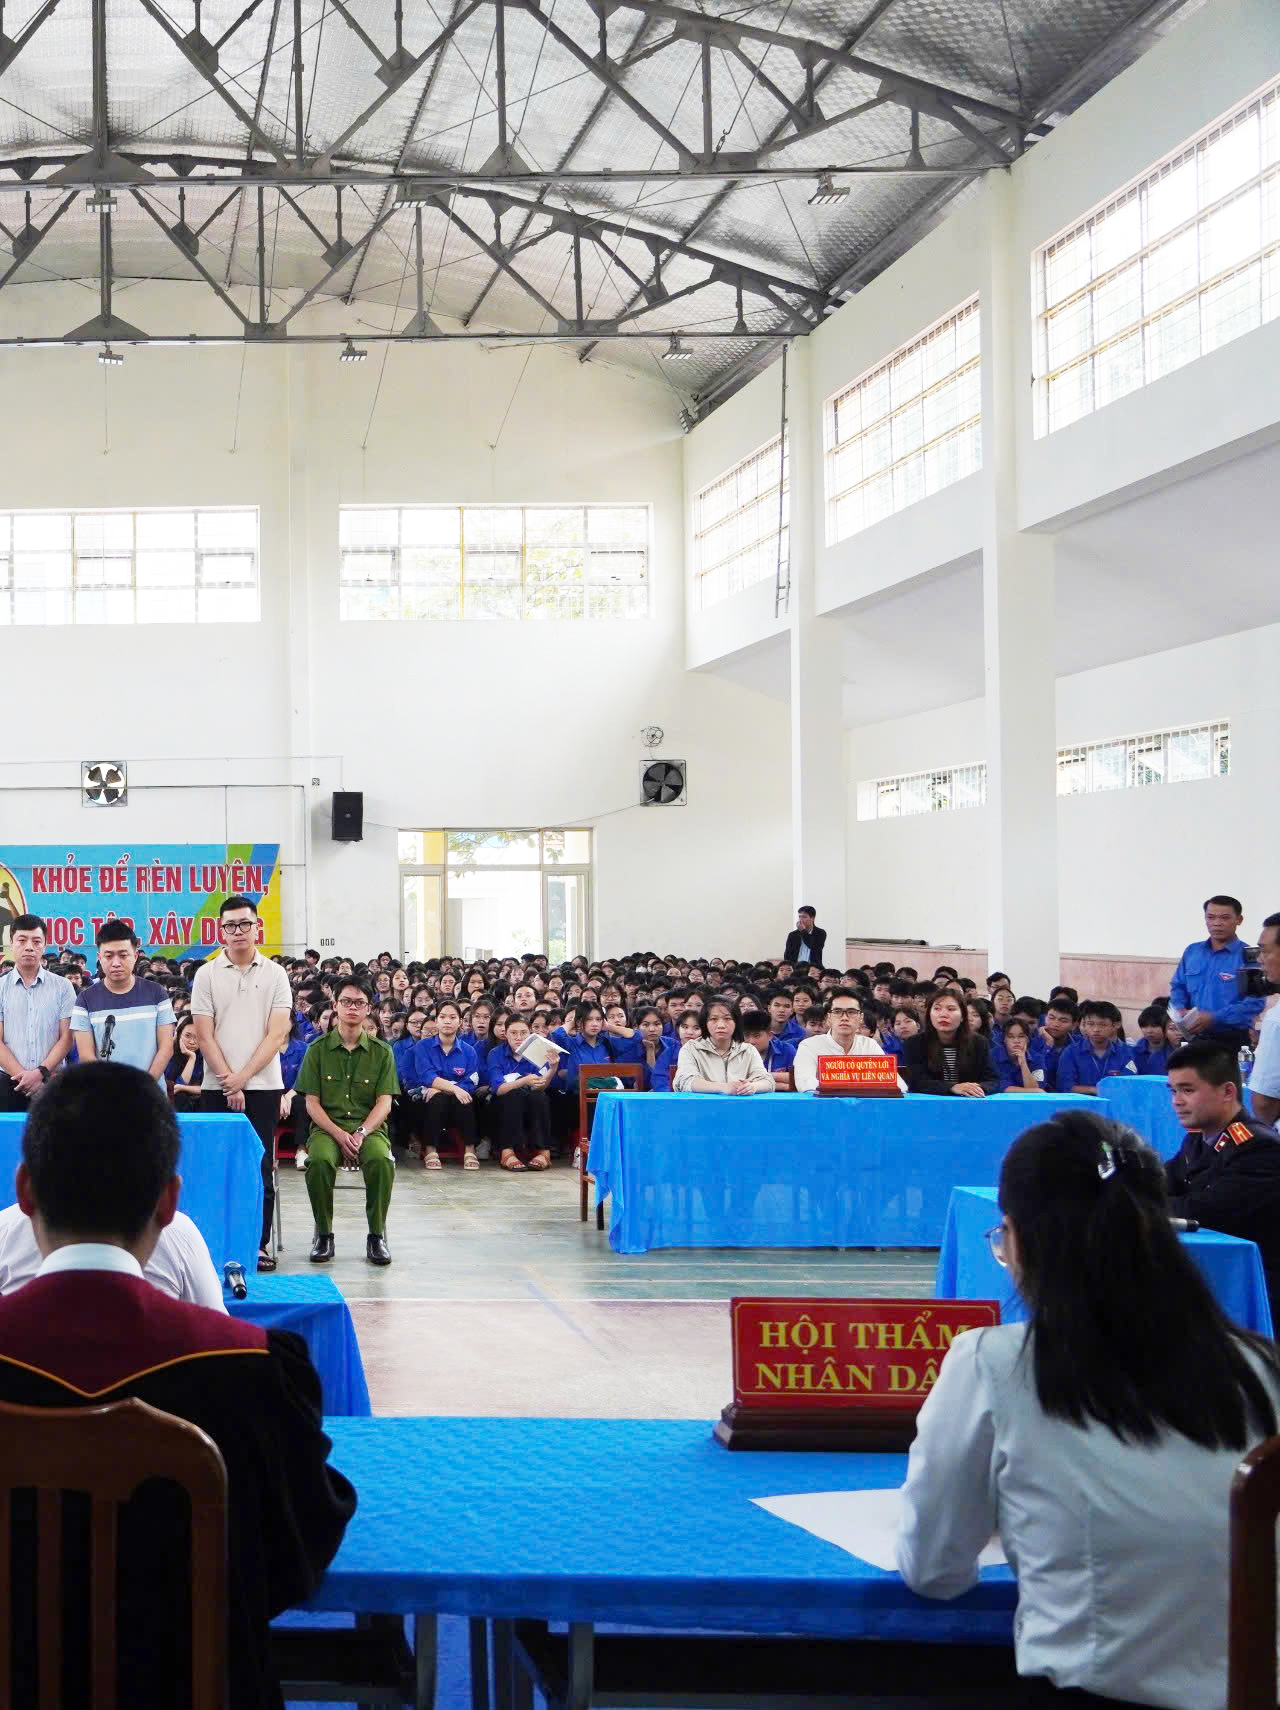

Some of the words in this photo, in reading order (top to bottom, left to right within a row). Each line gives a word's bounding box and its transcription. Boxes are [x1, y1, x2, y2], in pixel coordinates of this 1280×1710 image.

[32, 853, 91, 892] KHỎE
[99, 853, 130, 892] ĐỂ
[136, 859, 182, 892] RÈN
[149, 912, 194, 945] XÂY
[876, 1072, 895, 1081] QUAN
[759, 1315, 836, 1354] HỘI
[755, 1357, 875, 1390] NHÂN
[887, 1358, 938, 1392] DÂ
